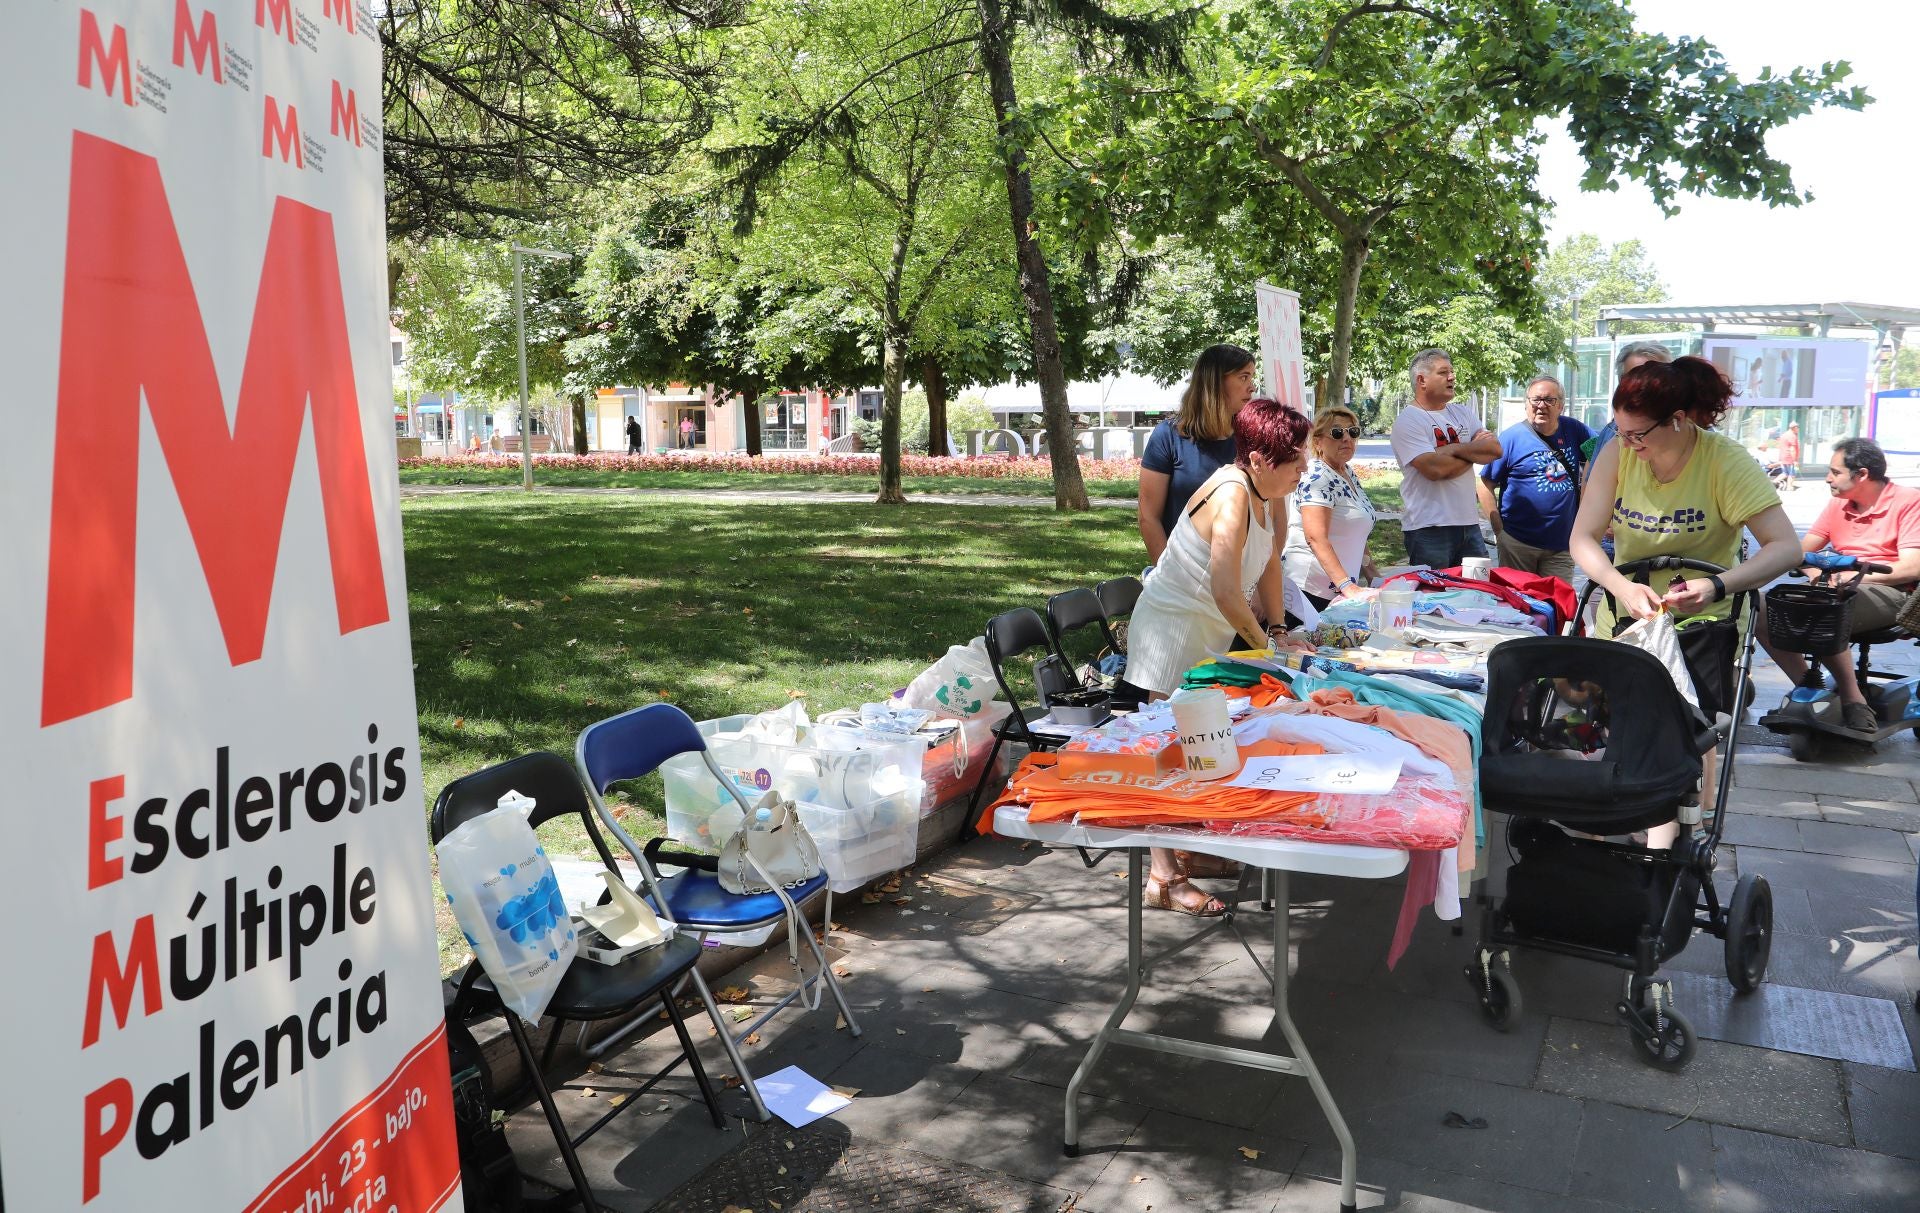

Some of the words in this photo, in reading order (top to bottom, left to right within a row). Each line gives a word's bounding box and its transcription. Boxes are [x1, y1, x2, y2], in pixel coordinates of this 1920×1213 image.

[77, 8, 133, 107] M
[172, 0, 223, 85] M
[262, 94, 303, 170] M
[330, 79, 361, 148] M
[43, 129, 390, 727] M
[88, 722, 406, 892] Esclerosis
[1187, 755, 1204, 771] M
[81, 842, 376, 1050] Múltiple
[83, 958, 388, 1206] Palencia
[338, 1138, 367, 1187] 23
[385, 1087, 428, 1143] bajo,
